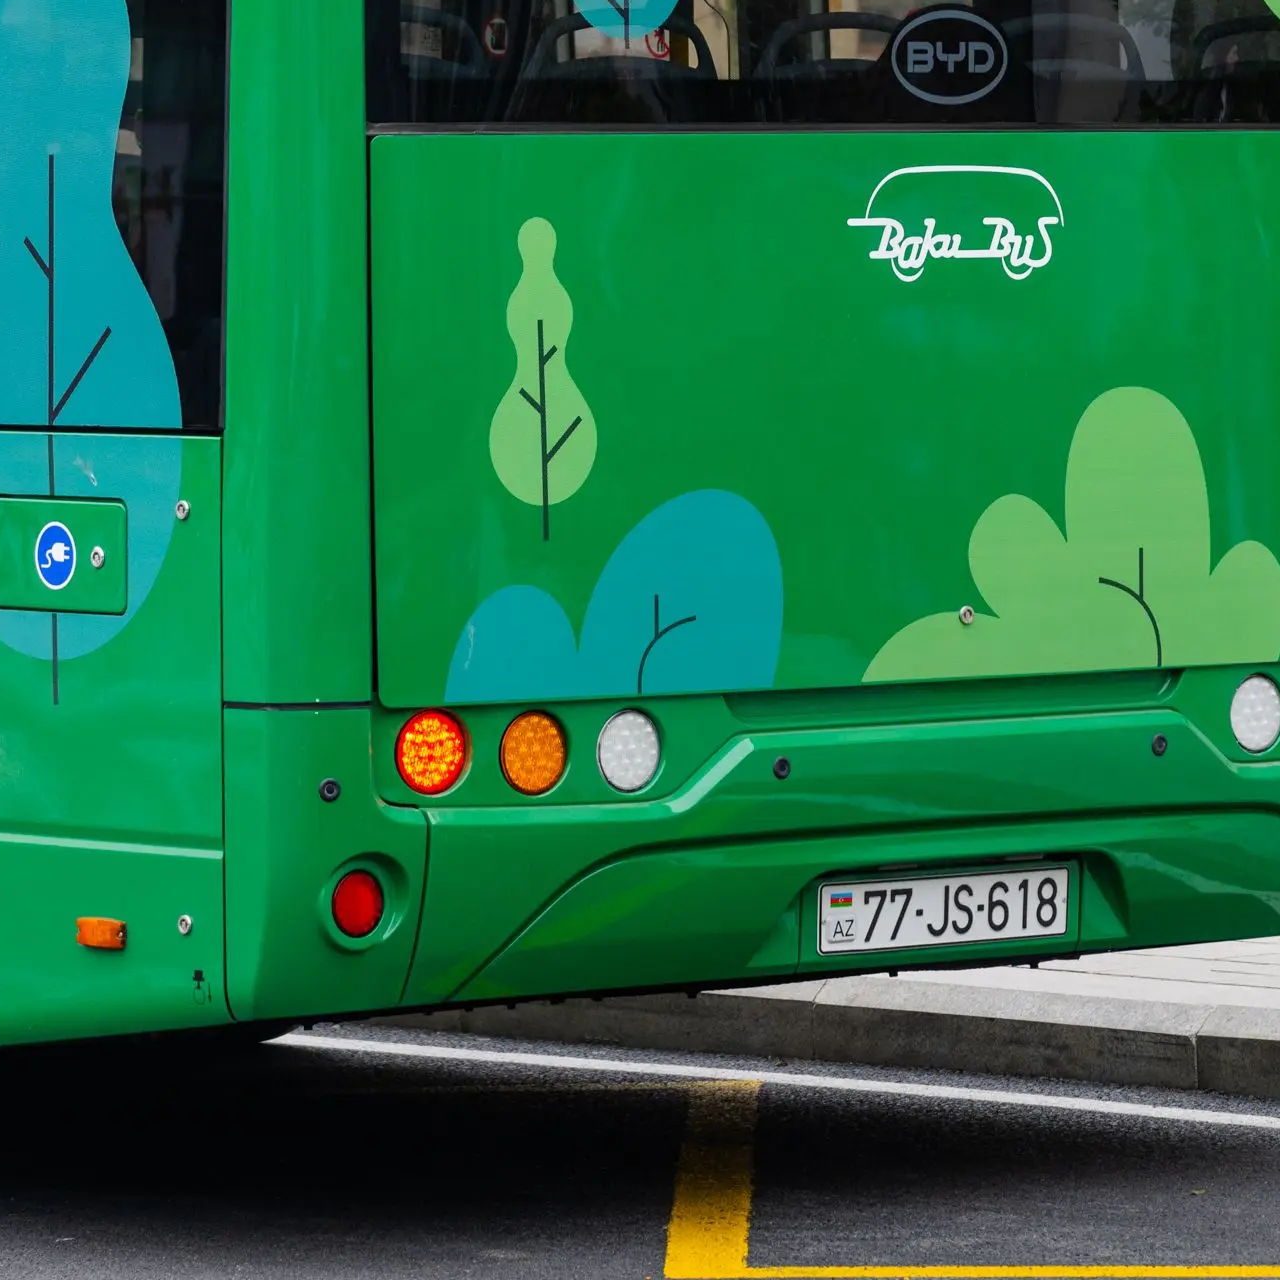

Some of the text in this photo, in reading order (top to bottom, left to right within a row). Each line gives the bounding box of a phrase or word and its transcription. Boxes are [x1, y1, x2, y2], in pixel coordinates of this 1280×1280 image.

[906, 41, 995, 74] BYD
[847, 217, 962, 269] Baku
[832, 919, 855, 938] AZ
[864, 877, 1059, 943] 77-JS-618
